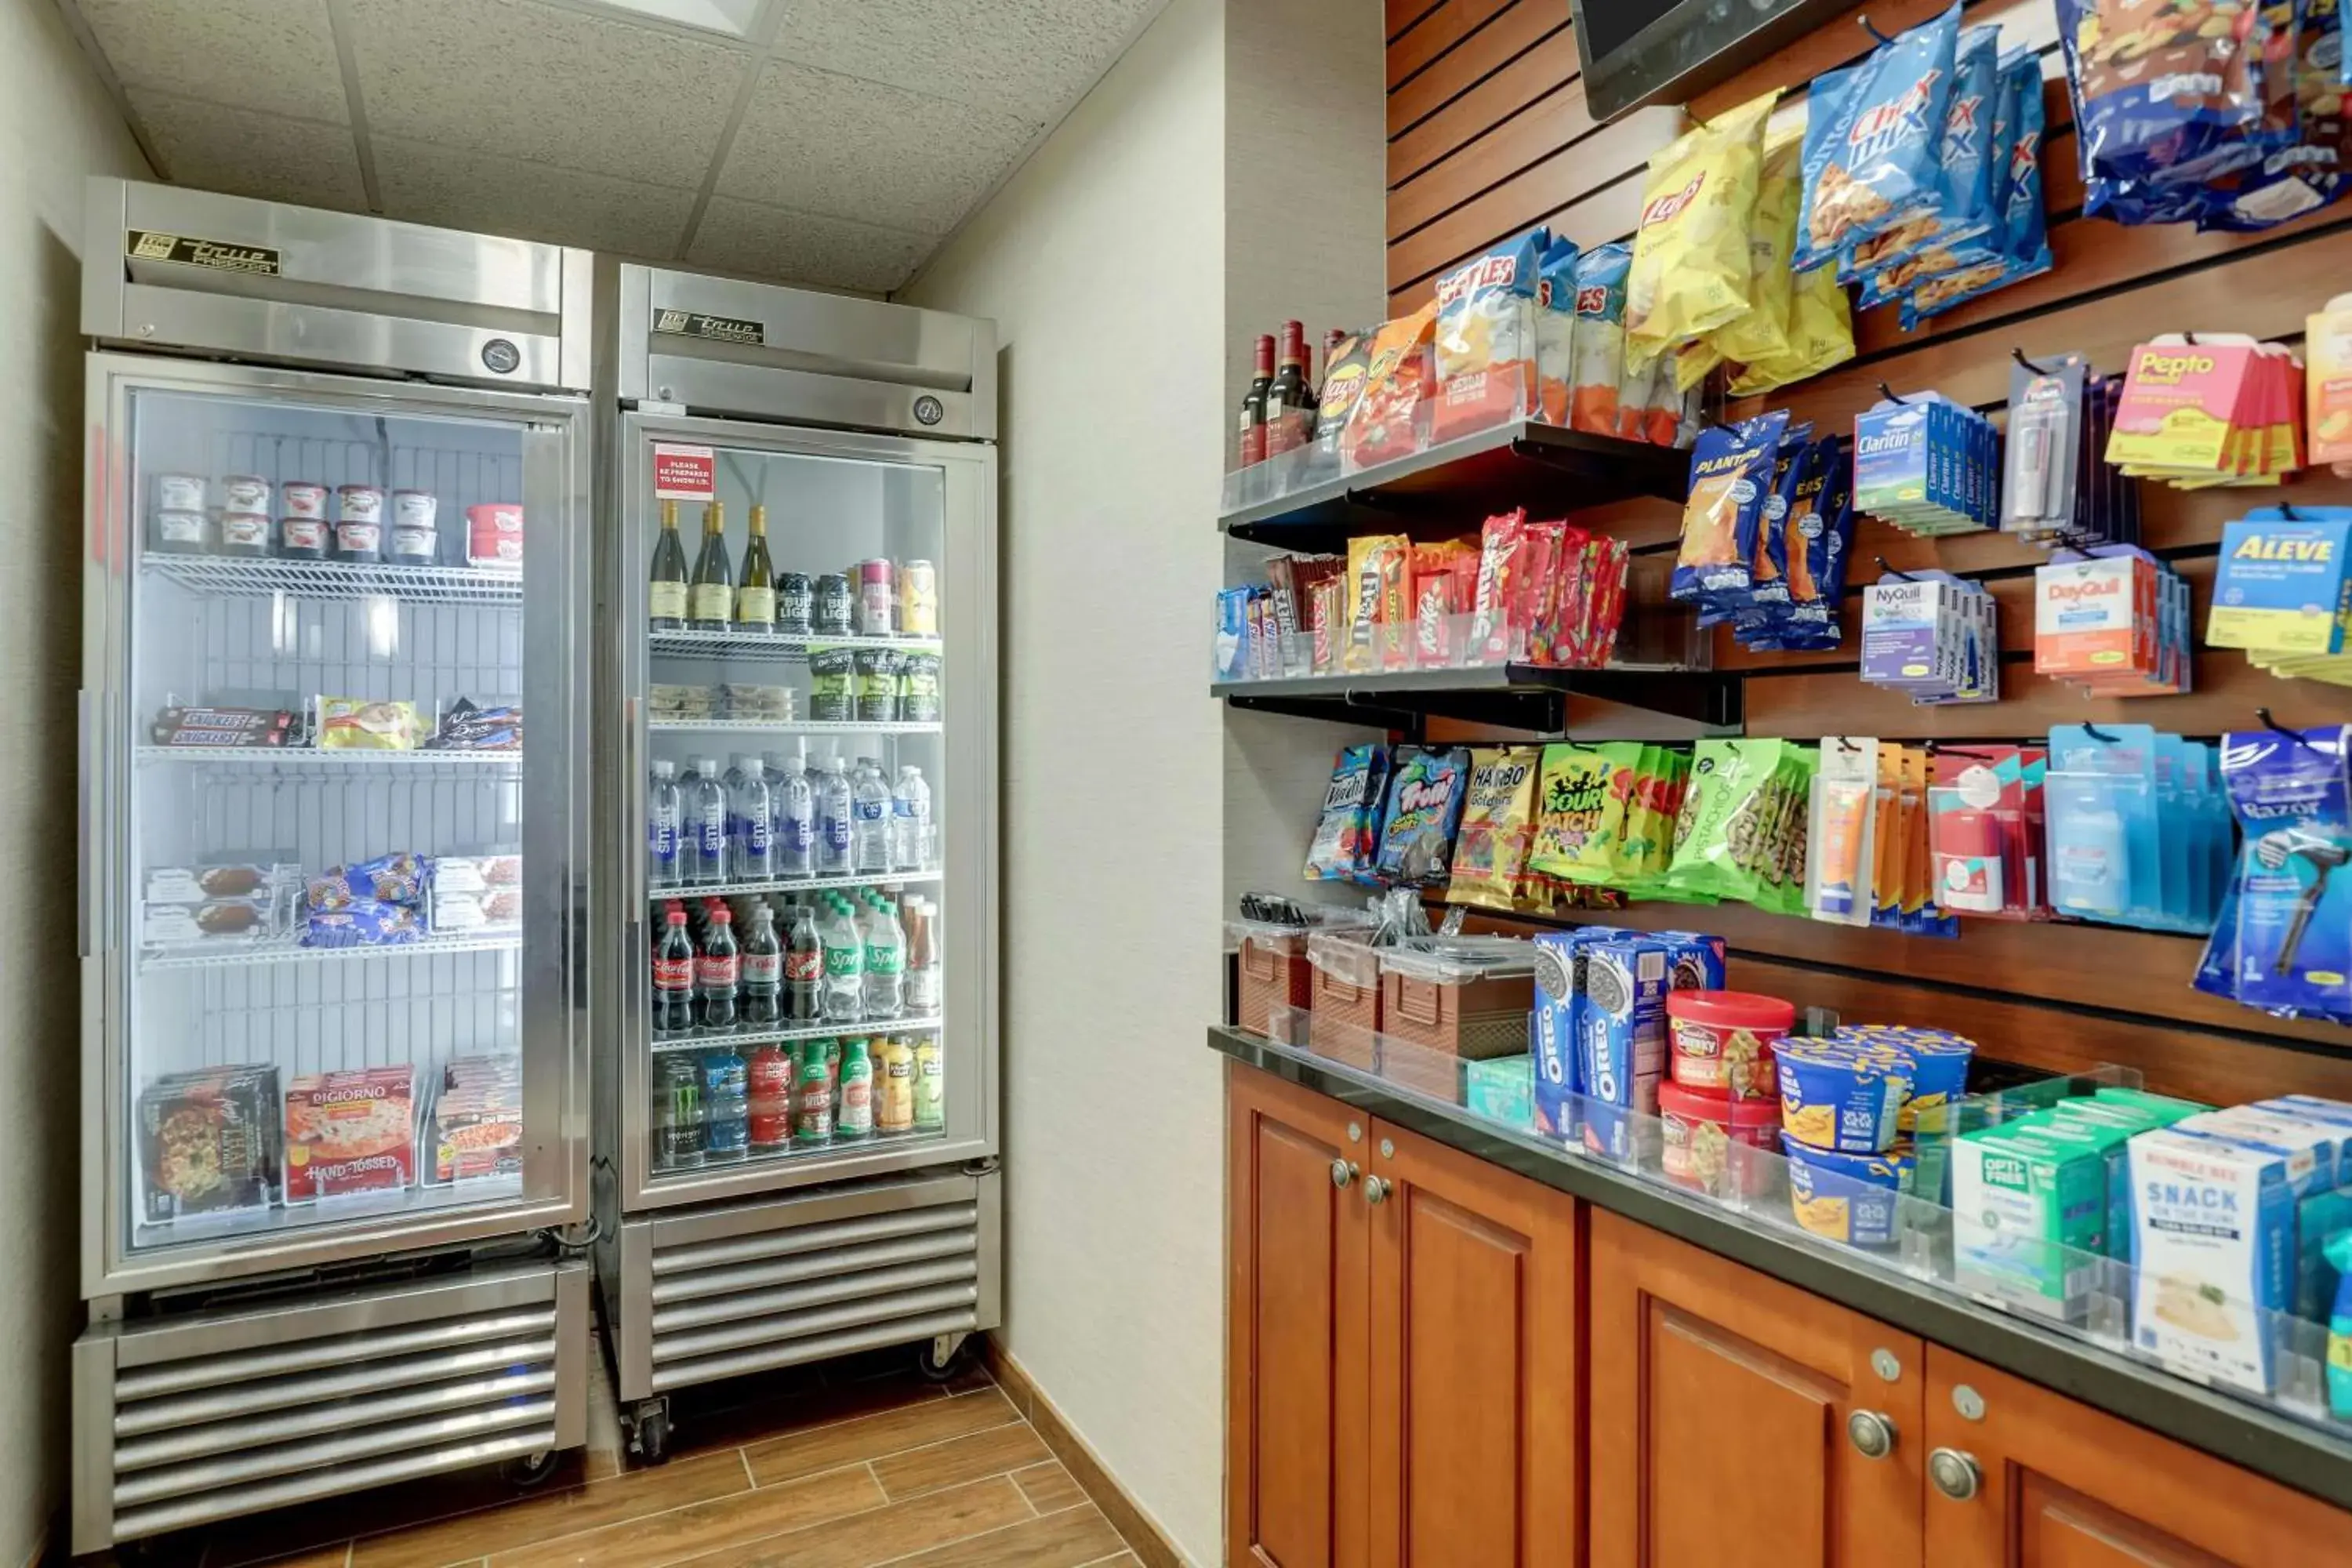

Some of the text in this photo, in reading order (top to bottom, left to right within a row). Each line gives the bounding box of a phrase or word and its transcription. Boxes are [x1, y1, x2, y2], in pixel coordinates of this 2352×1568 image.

[2140, 352, 2214, 378] Pepto
[1858, 428, 1910, 455] Claritin
[2233, 535, 2335, 561] ALEVE
[1876, 587, 1922, 604] NyQuil
[1546, 788, 1604, 812] SOUR
[2241, 800, 2322, 820] Razor
[656, 806, 671, 855] smart
[1542, 810, 1602, 833] PATCH
[1542, 1004, 1563, 1084] OREO
[1595, 1018, 1617, 1102] OREO
[312, 1086, 387, 1104] DIGIORNO
[2147, 1181, 2239, 1212] SNACK
